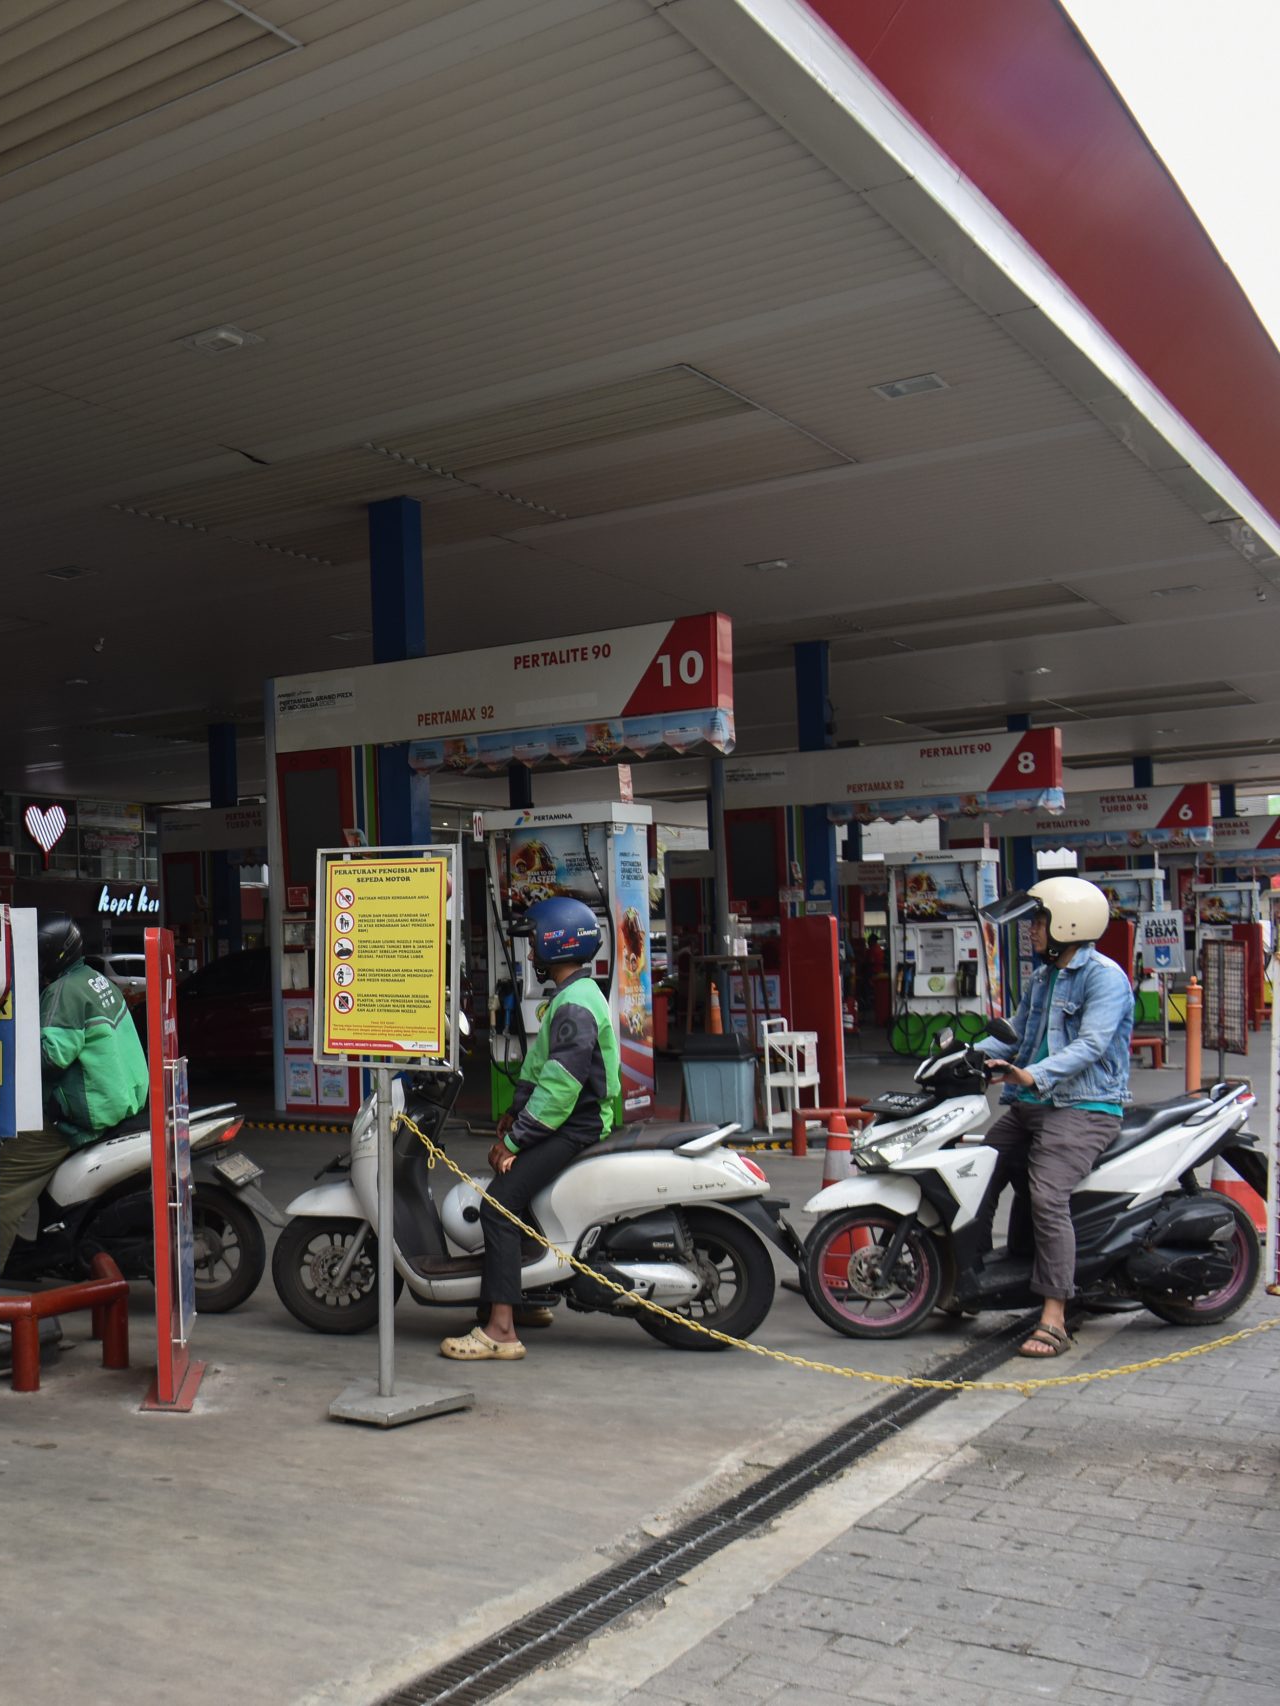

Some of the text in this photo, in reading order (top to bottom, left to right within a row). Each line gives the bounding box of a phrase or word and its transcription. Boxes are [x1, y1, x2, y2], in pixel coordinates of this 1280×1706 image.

[513, 643, 612, 670] PERTALITE 90
[656, 649, 705, 687] 10
[417, 705, 494, 727] PERTAMAX 92
[920, 742, 991, 758] PERTALITE 90
[1017, 751, 1036, 774] 8
[846, 780, 904, 794] PERTAMAX 92
[1100, 794, 1148, 805] PERTAMAX
[533, 812, 573, 822] PERTAMINA
[1178, 804, 1193, 821] 6
[473, 815, 483, 837] 10
[1036, 819, 1091, 830] PERTALITE 90
[527, 875, 557, 884] FASTER
[97, 885, 134, 917] kopi
[1144, 918, 1177, 927] JALUR
[1144, 926, 1179, 938] BBM
[1145, 937, 1180, 945] SUBSIDI
